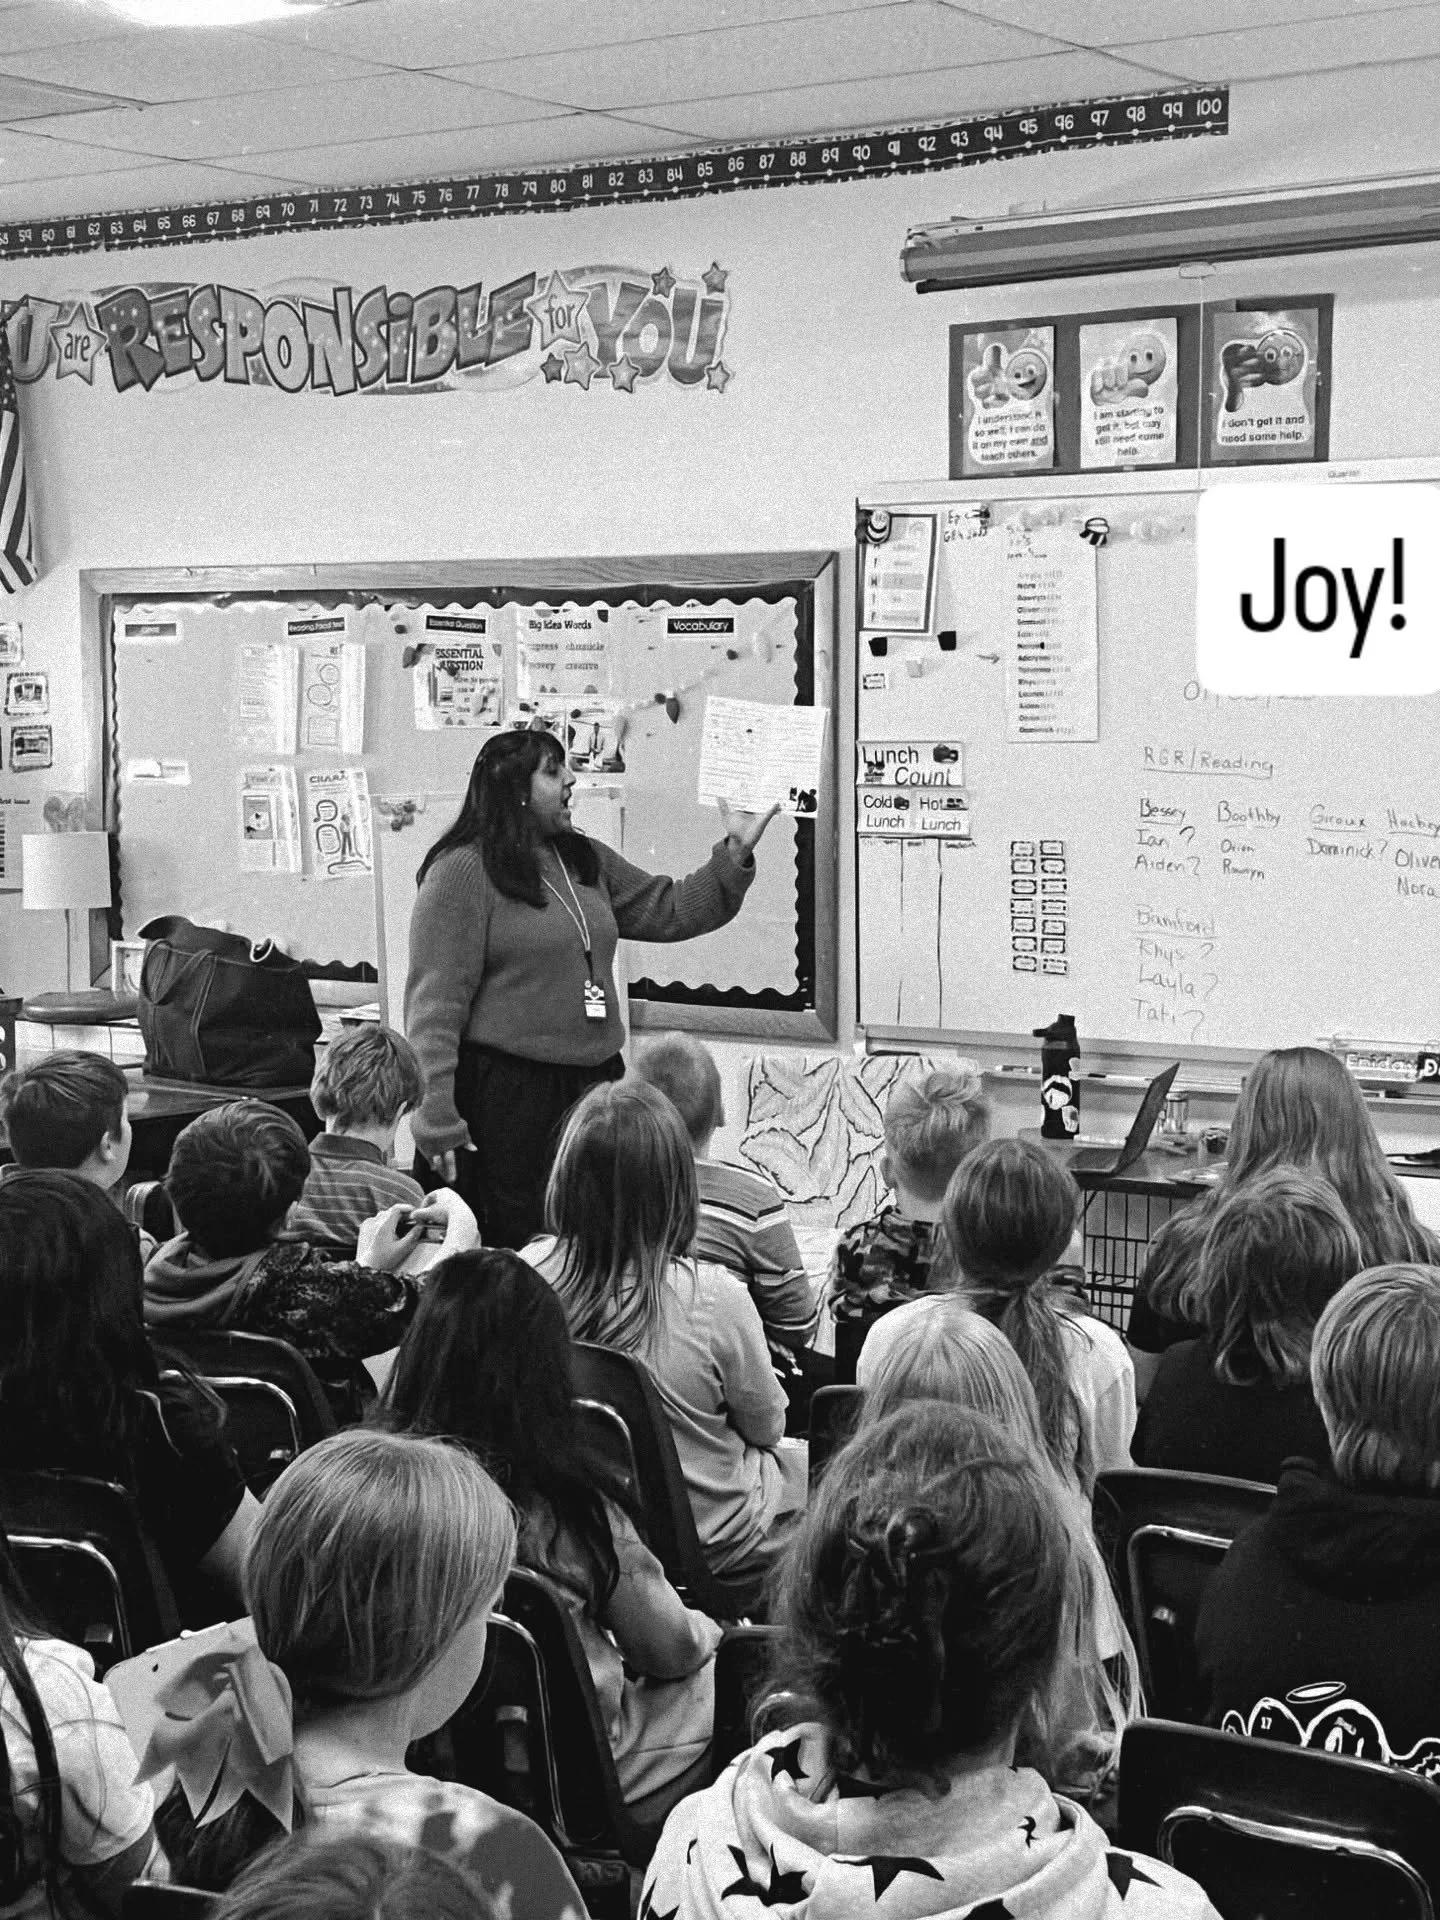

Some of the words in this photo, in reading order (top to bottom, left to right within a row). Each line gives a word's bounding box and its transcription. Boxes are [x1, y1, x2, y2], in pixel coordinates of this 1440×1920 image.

[19, 229, 31, 242] 59
[42, 229, 55, 241] 60
[67, 226, 75, 238] 61
[88, 223, 100, 235] 62
[111, 221, 123, 234] 63
[133, 220, 146, 232] 64
[158, 216, 170, 229] 65
[183, 215, 196, 227] 66
[207, 212, 219, 225] 67
[232, 209, 244, 222] 68
[256, 205, 270, 218] 69
[282, 203, 295, 216] 70
[309, 200, 318, 212] 71
[334, 199, 346, 211] 72
[360, 196, 372, 209] 73
[386, 193, 399, 206] 74
[413, 191, 425, 204] 75
[439, 189, 452, 202] 76
[467, 185, 479, 199] 77
[495, 184, 508, 197] 78
[523, 181, 537, 194] 79
[551, 179, 566, 193] 80
[582, 174, 592, 188] 81
[609, 172, 624, 186] 82
[638, 169, 653, 183] 83
[667, 167, 683, 182] 84
[698, 162, 713, 177] 85
[728, 157, 744, 172] 86
[759, 154, 774, 169] 87
[790, 152, 806, 166] 88
[822, 148, 839, 163] 89
[853, 145, 870, 160] 90
[888, 141, 900, 155] 91
[919, 137, 935, 151] 92
[951, 131, 968, 146] 93
[984, 126, 1003, 141] 94
[1020, 119, 1037, 134] 95
[1055, 115, 1073, 130] 96
[1091, 110, 1109, 126] 97
[1127, 106, 1145, 122] 98
[1163, 102, 1182, 118] 99
[1197, 98, 1221, 116] 100
[64, 333, 91, 362] are
[95, 271, 537, 396] RESPONSIBLE
[544, 295, 575, 334] for
[575, 281, 727, 385] YOU
[1228, 418, 1255, 428] don't
[1256, 417, 1274, 428] get
[1285, 415, 1306, 425] and
[1221, 433, 1247, 443] need
[1248, 432, 1277, 442] some
[564, 620, 592, 630] Words
[673, 620, 729, 633] Vocabulary
[435, 648, 485, 659] ESSENTIAL
[862, 745, 920, 765] Lunch
[894, 766, 952, 787] Count
[863, 794, 893, 809] Cold
[919, 797, 945, 811] Hot
[866, 814, 905, 828] Lunch
[921, 817, 961, 831] Lunch
